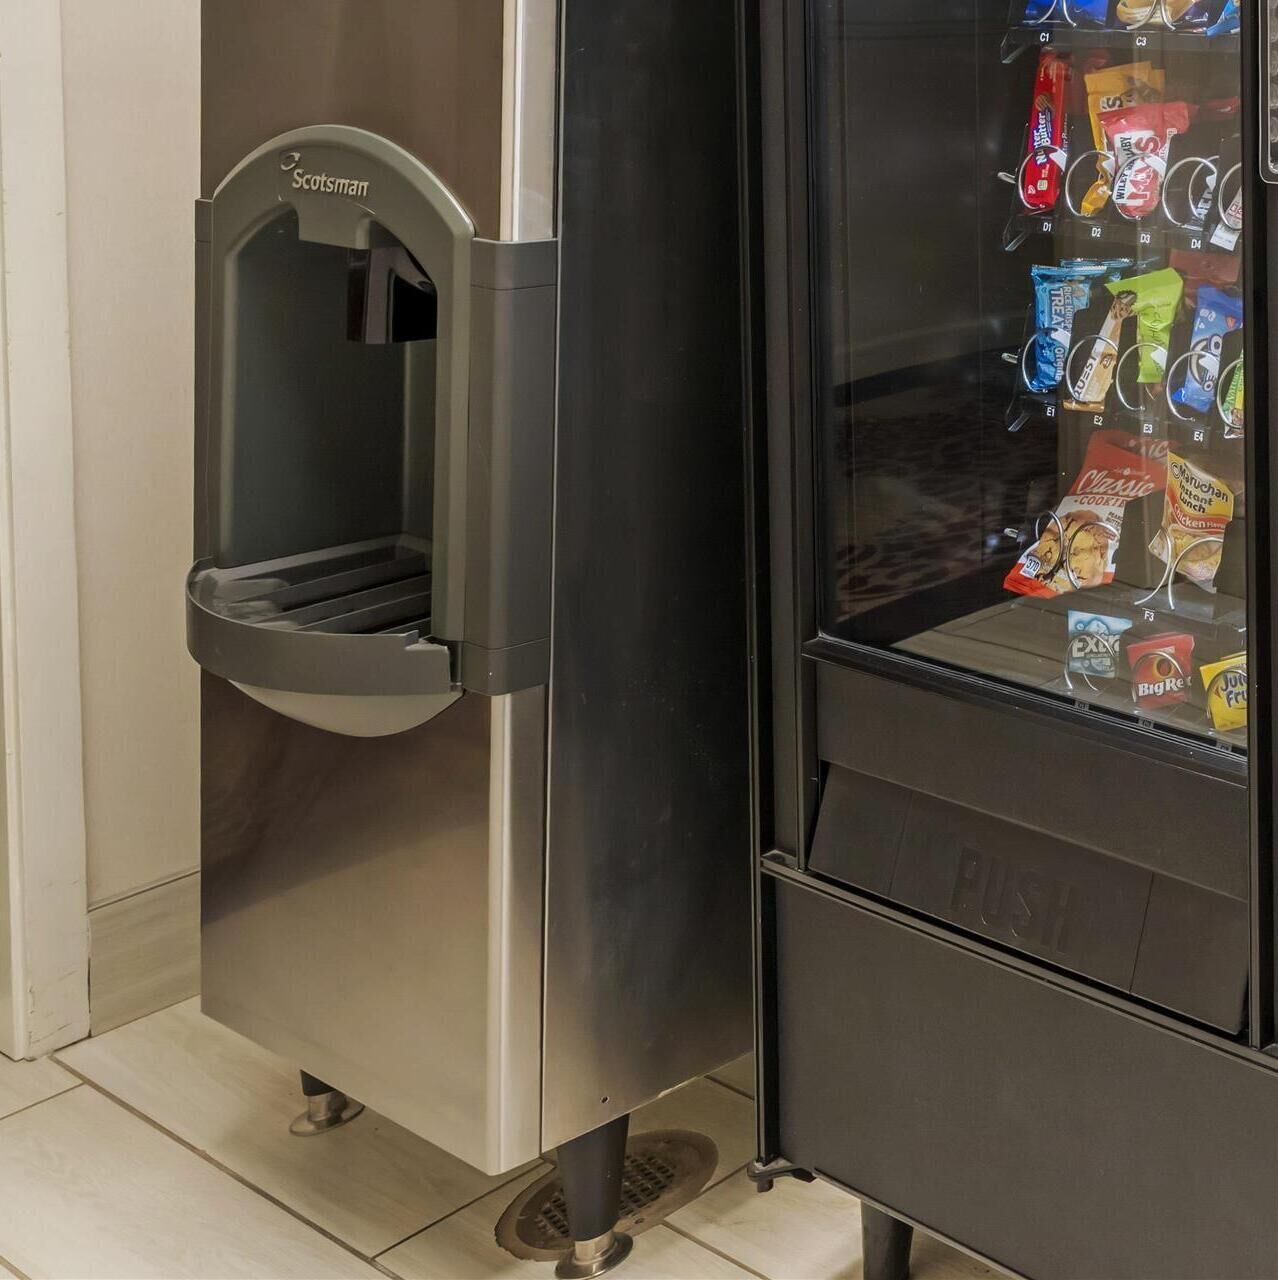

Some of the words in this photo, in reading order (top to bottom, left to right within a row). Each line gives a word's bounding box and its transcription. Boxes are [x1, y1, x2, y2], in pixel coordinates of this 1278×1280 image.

[1040, 32, 1049, 42] C1
[1136, 37, 1146, 46] C3
[292, 169, 369, 196] Scotsman
[1043, 222, 1051, 232] D1
[1092, 227, 1101, 238] D2
[1140, 233, 1150, 243] D3
[1094, 416, 1103, 425] E2
[1144, 425, 1153, 434] E3
[1194, 432, 1204, 441] E4
[1077, 469, 1155, 497] Classic
[1180, 463, 1228, 502] Maruchan
[1179, 481, 1214, 505] Instant
[1179, 493, 1205, 513] Lunch
[1145, 611, 1154, 621] F3
